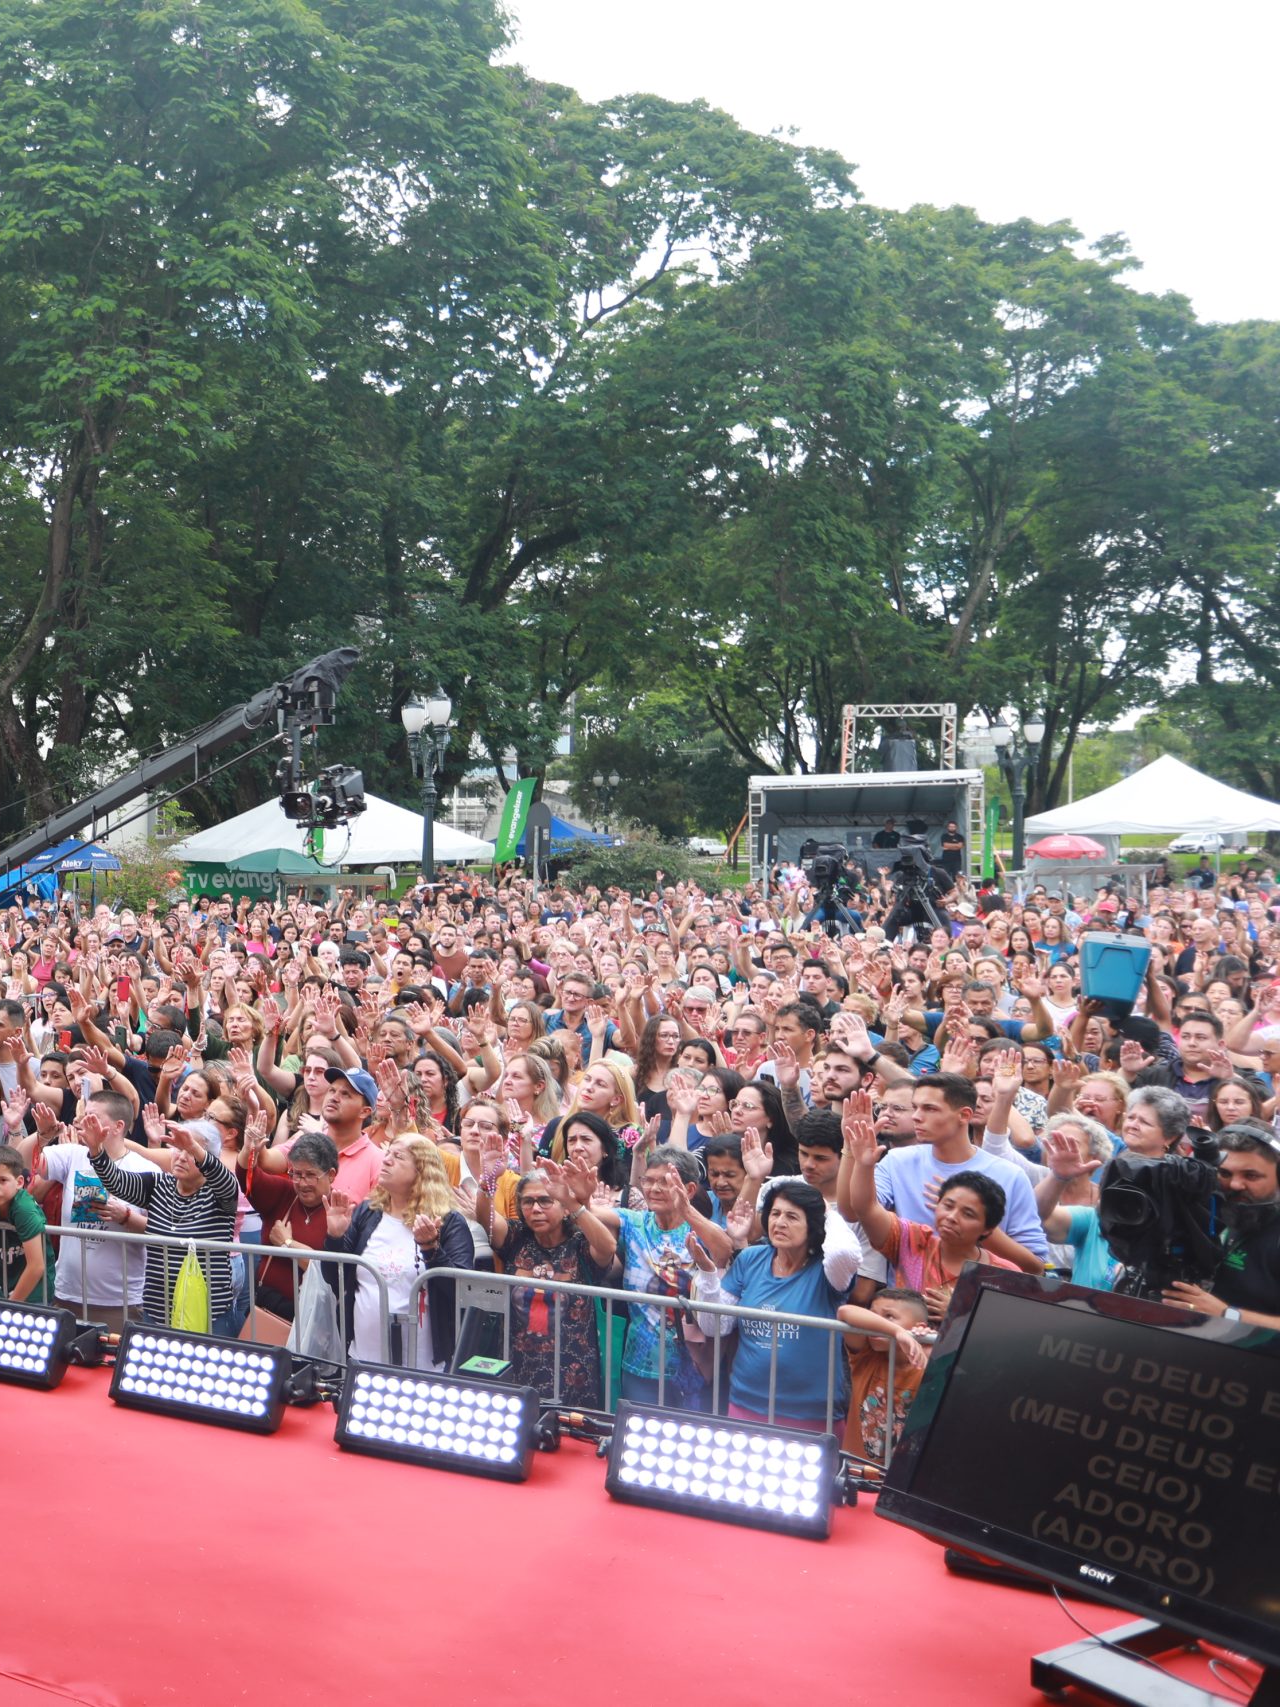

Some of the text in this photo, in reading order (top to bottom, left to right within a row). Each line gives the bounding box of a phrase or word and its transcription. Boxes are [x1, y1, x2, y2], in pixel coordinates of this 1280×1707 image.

[187, 873, 209, 889] TV
[1038, 1334, 1122, 1374] MEU
[1131, 1358, 1249, 1407] DEUS
[1009, 1396, 1110, 1441] (MEU
[1115, 1425, 1234, 1480] DEUS
[1102, 1386, 1235, 1440] CREIO
[1087, 1455, 1202, 1513] CEIO)
[1053, 1482, 1212, 1550] ADORO
[1032, 1510, 1216, 1597] (ADORO)
[1080, 1564, 1116, 1584] SONY
